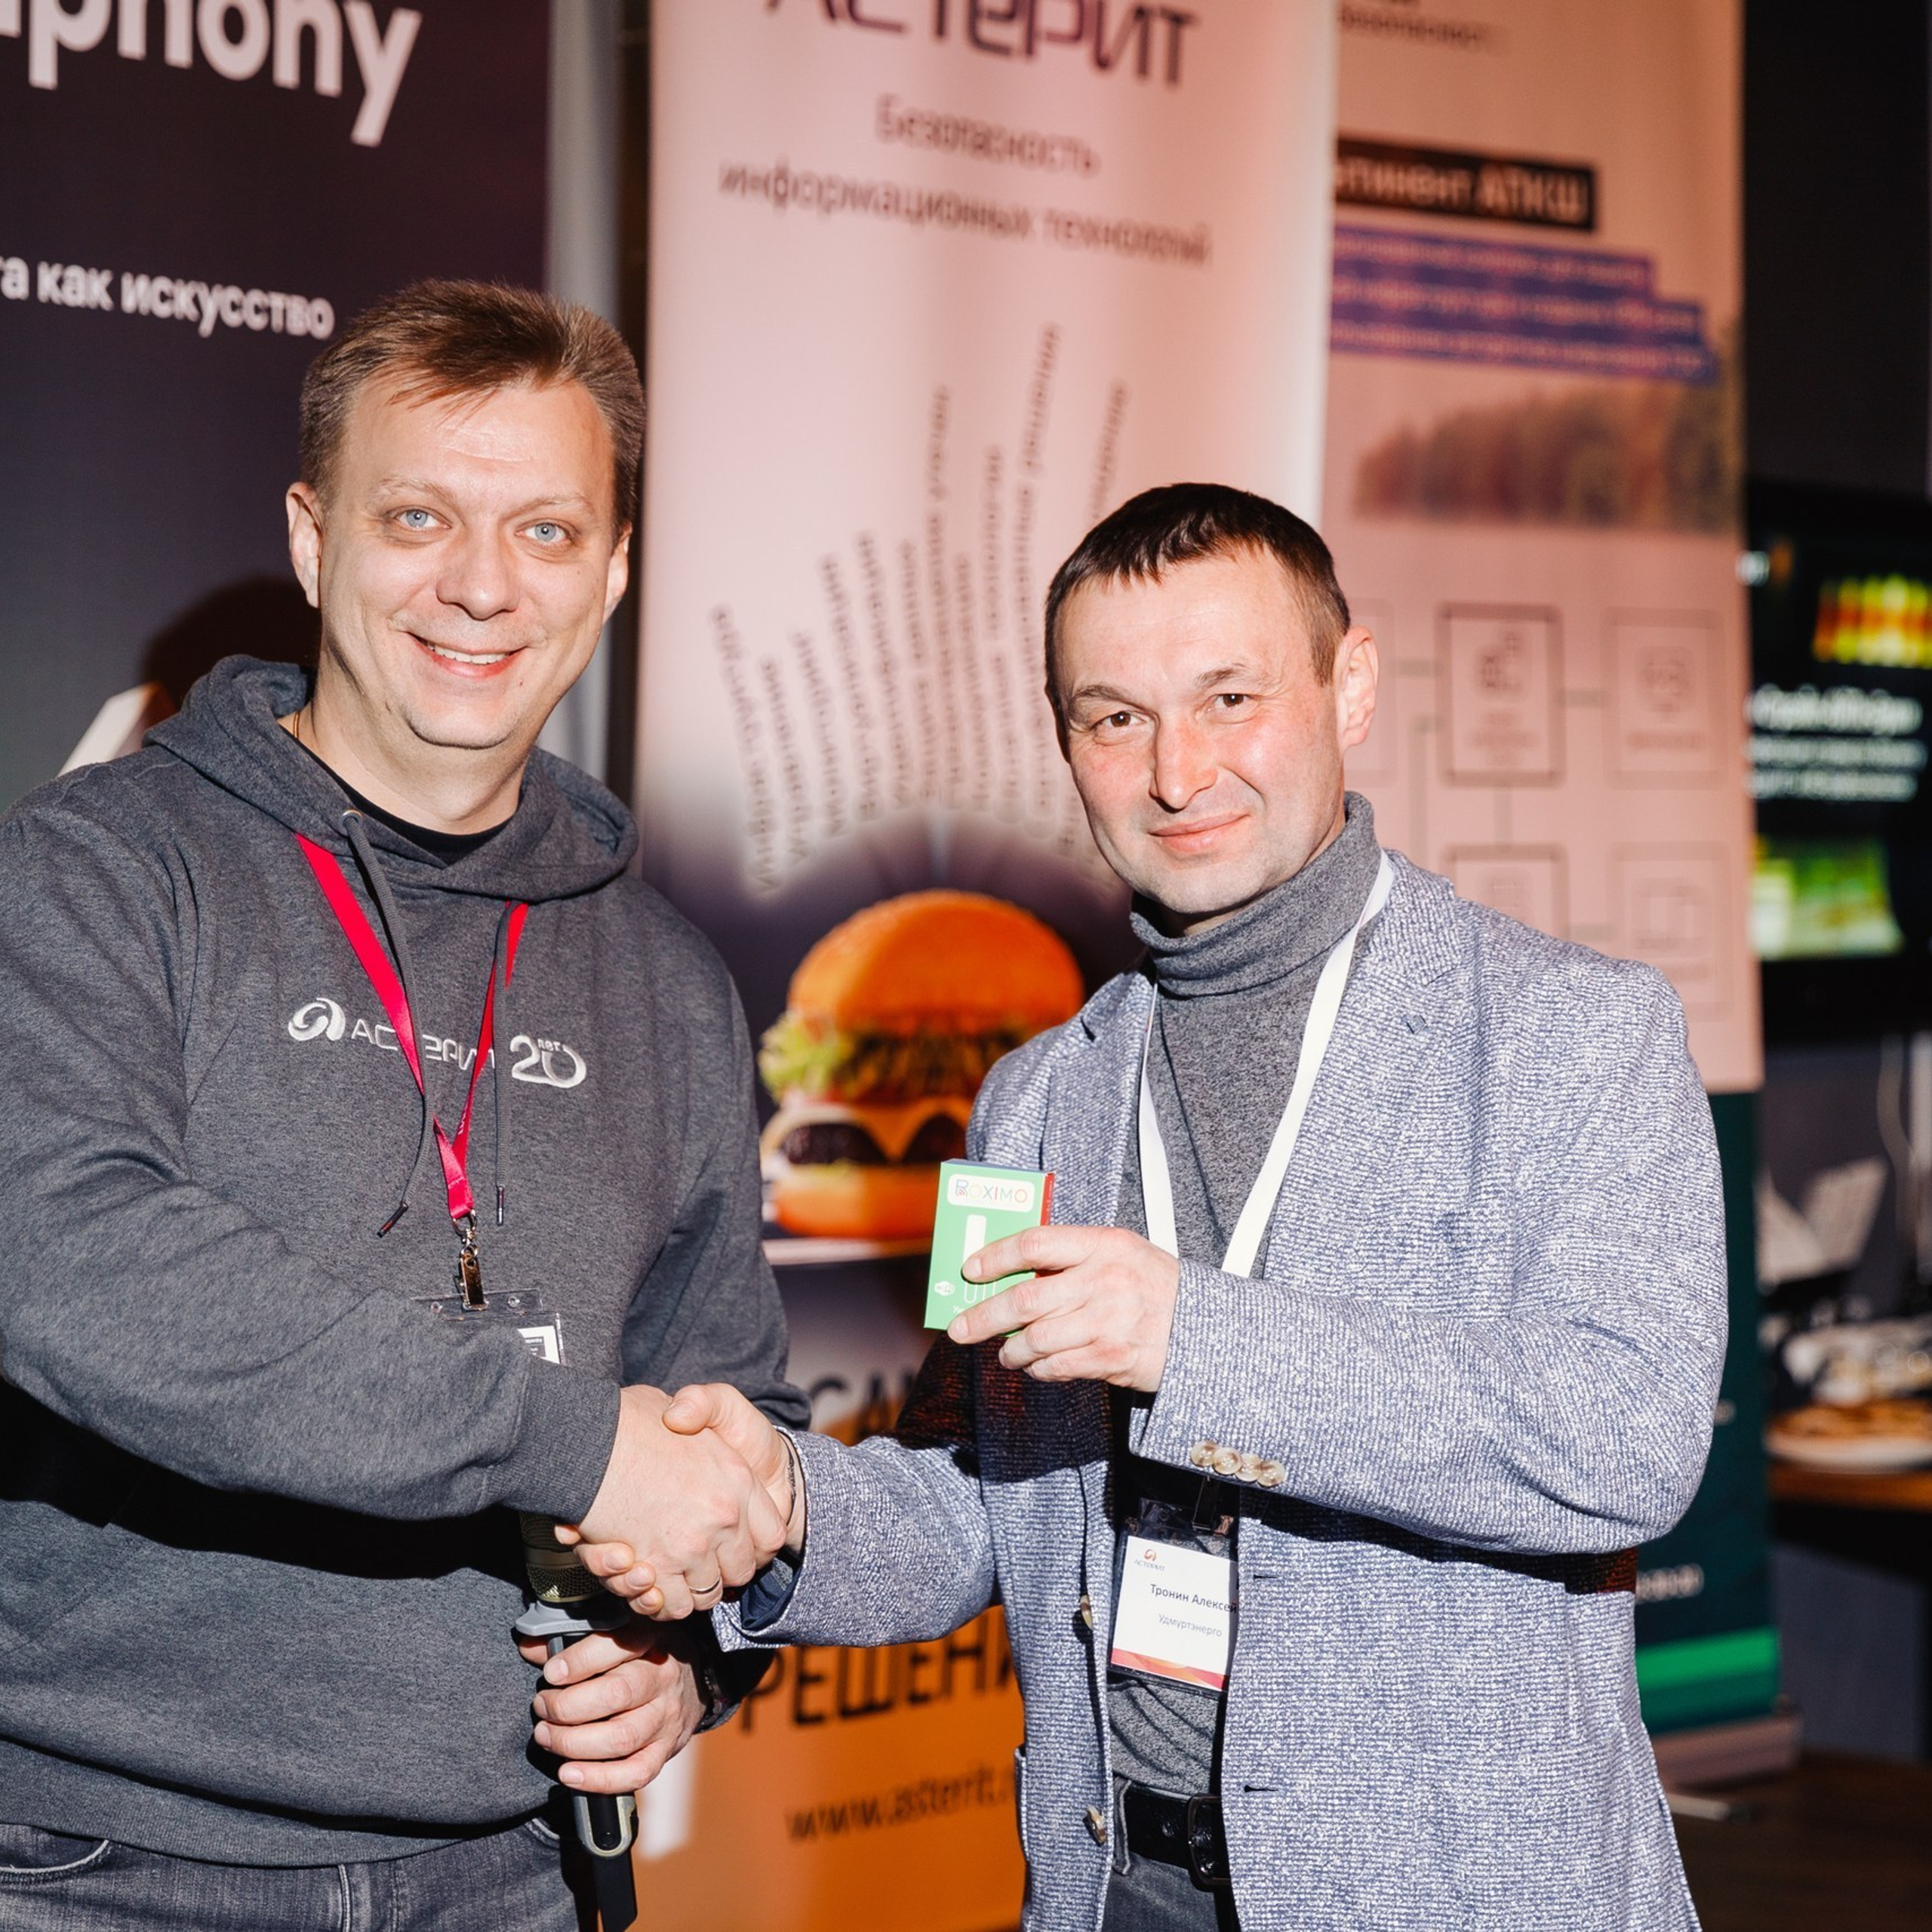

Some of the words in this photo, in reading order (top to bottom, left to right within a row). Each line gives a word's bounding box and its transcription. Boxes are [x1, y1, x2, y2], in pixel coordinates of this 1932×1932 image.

[0, 0, 422, 147] phony
[0, 256, 29, 300] а
[37, 261, 114, 311] как
[121, 272, 335, 340] искусство
[510, 1035, 586, 1088] 20
[955, 1179, 1029, 1204] ROXIMO
[1150, 1583, 1189, 1602] Тронин
[1192, 1594, 1238, 1614] Алексей
[1158, 1614, 1223, 1638] Удмуртэнерго
